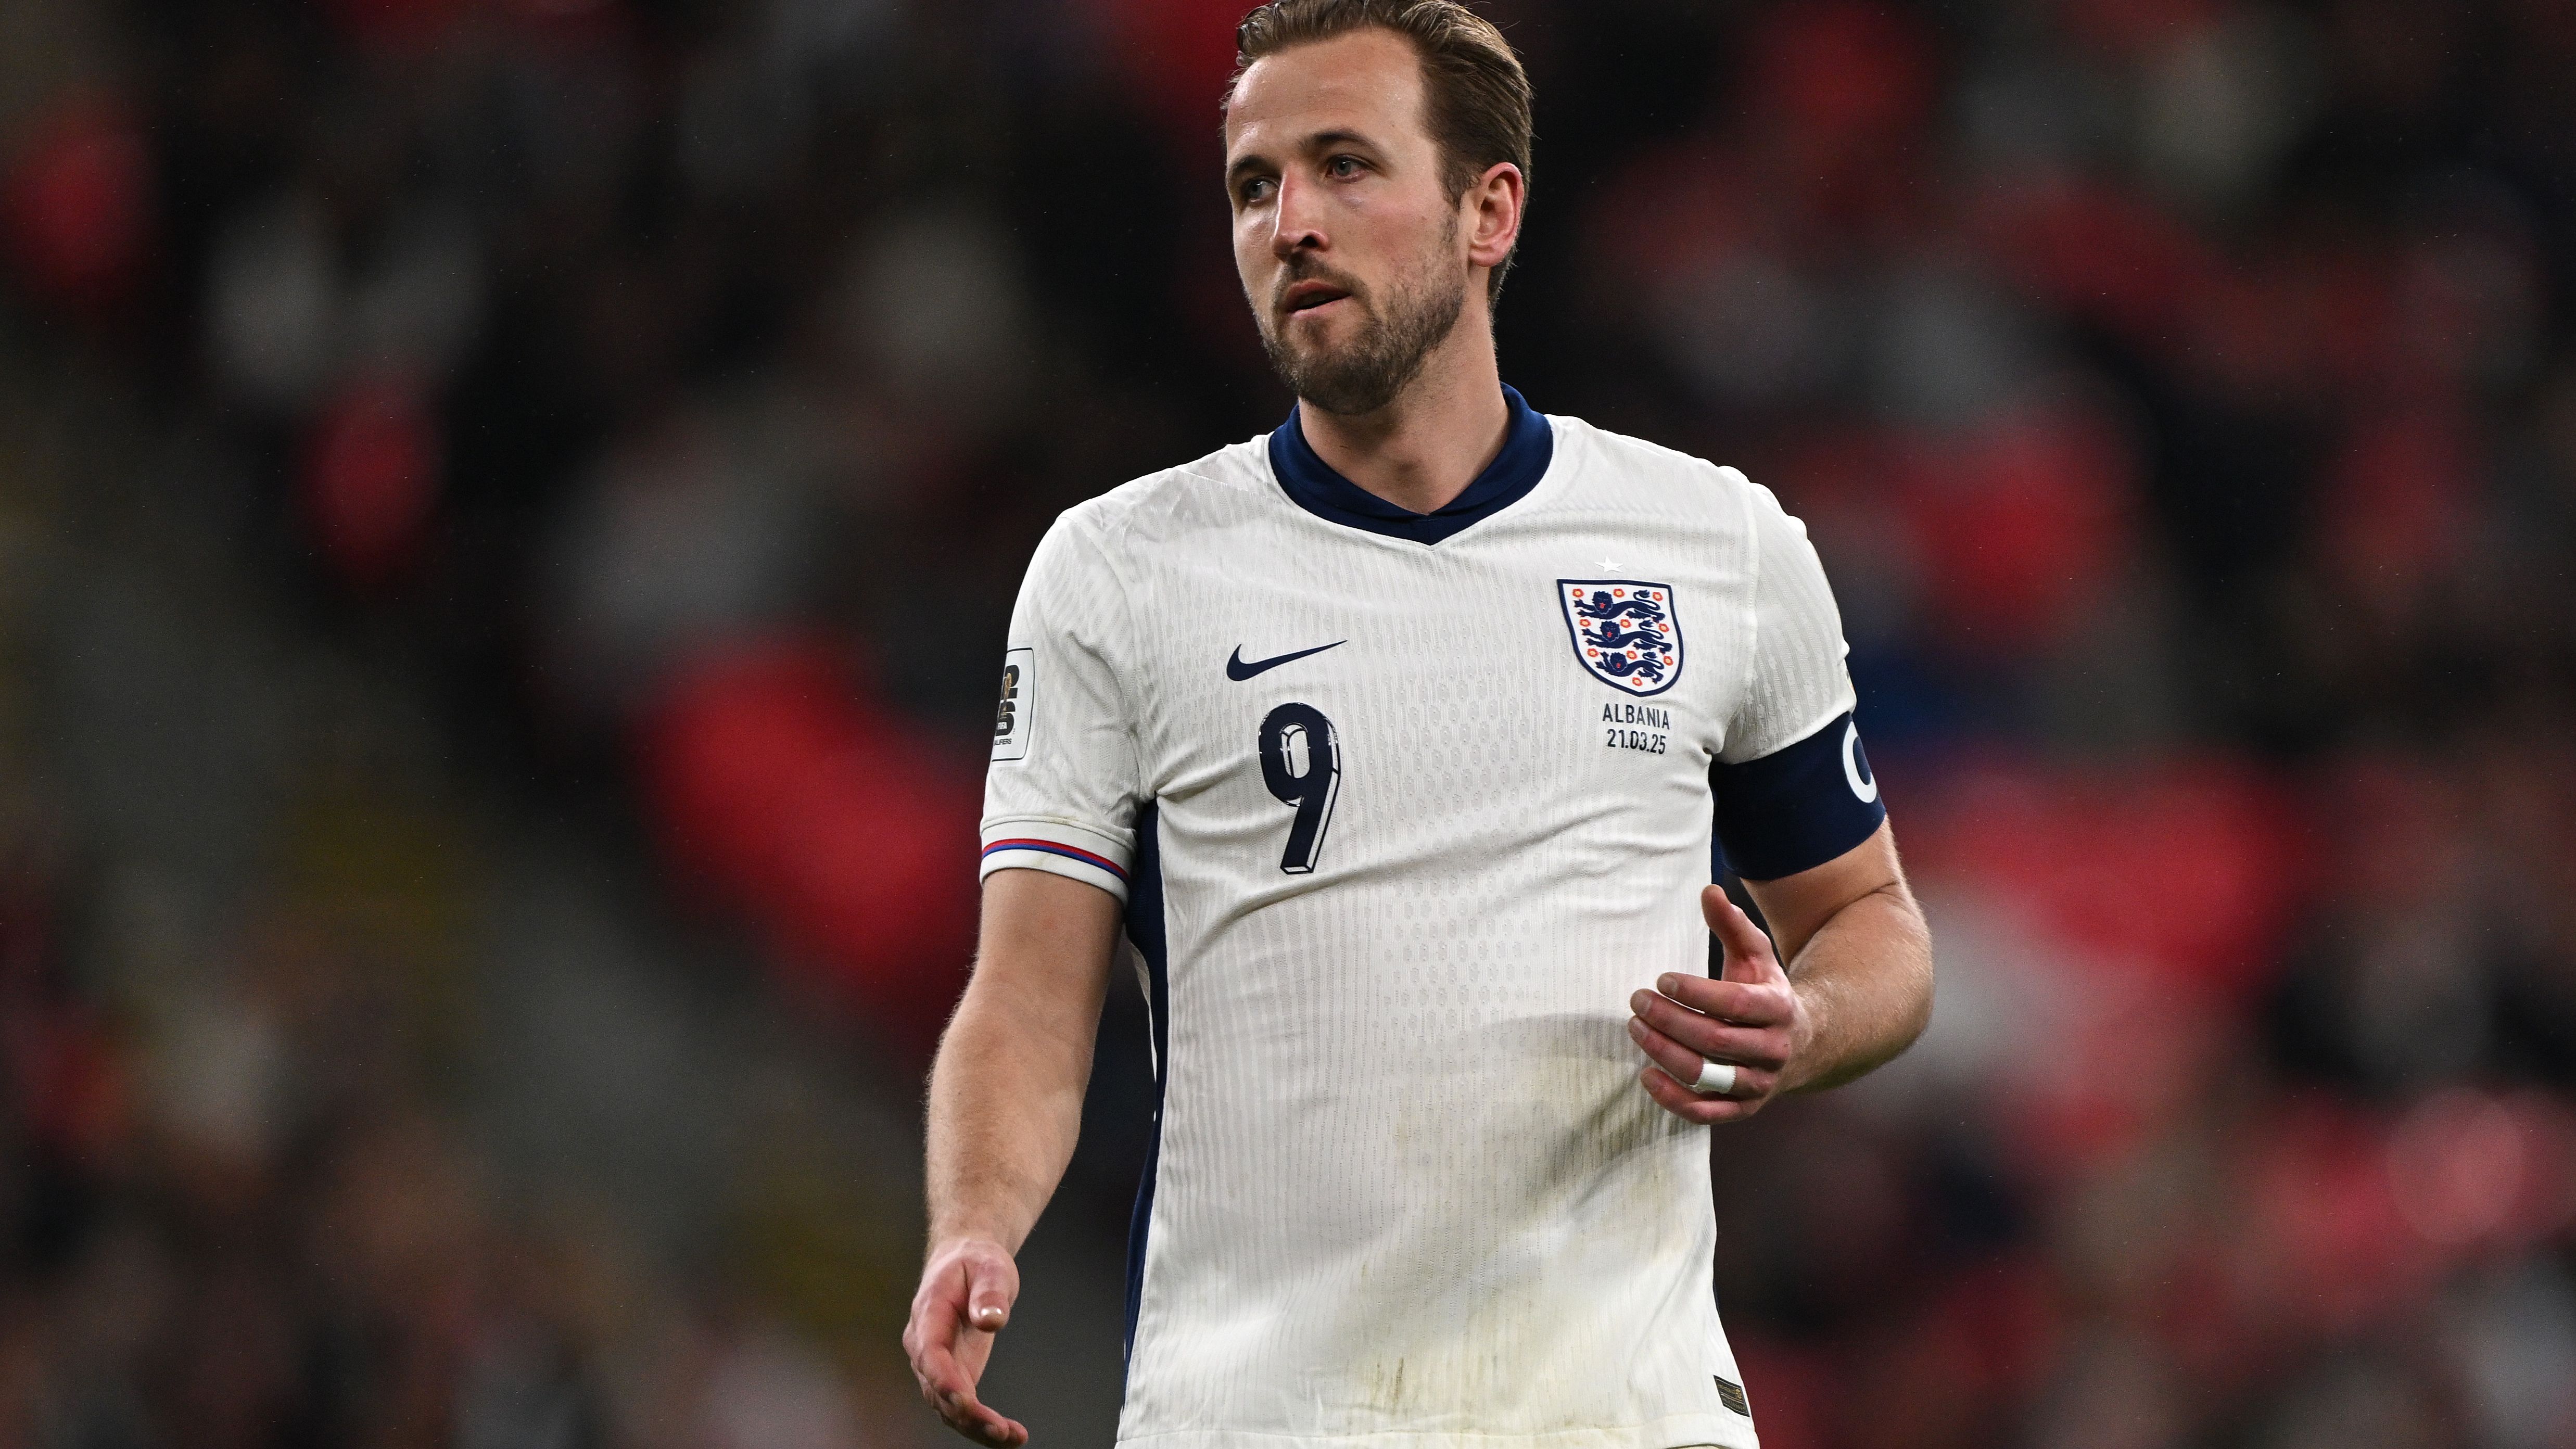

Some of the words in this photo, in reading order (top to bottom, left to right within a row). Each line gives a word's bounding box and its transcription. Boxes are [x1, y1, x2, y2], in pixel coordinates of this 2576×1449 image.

[1603, 704, 1669, 729] ALBANIA
[1607, 729, 1666, 754] 21.03.25
[1259, 703, 1340, 874] 9
[1843, 721, 1877, 803] C
